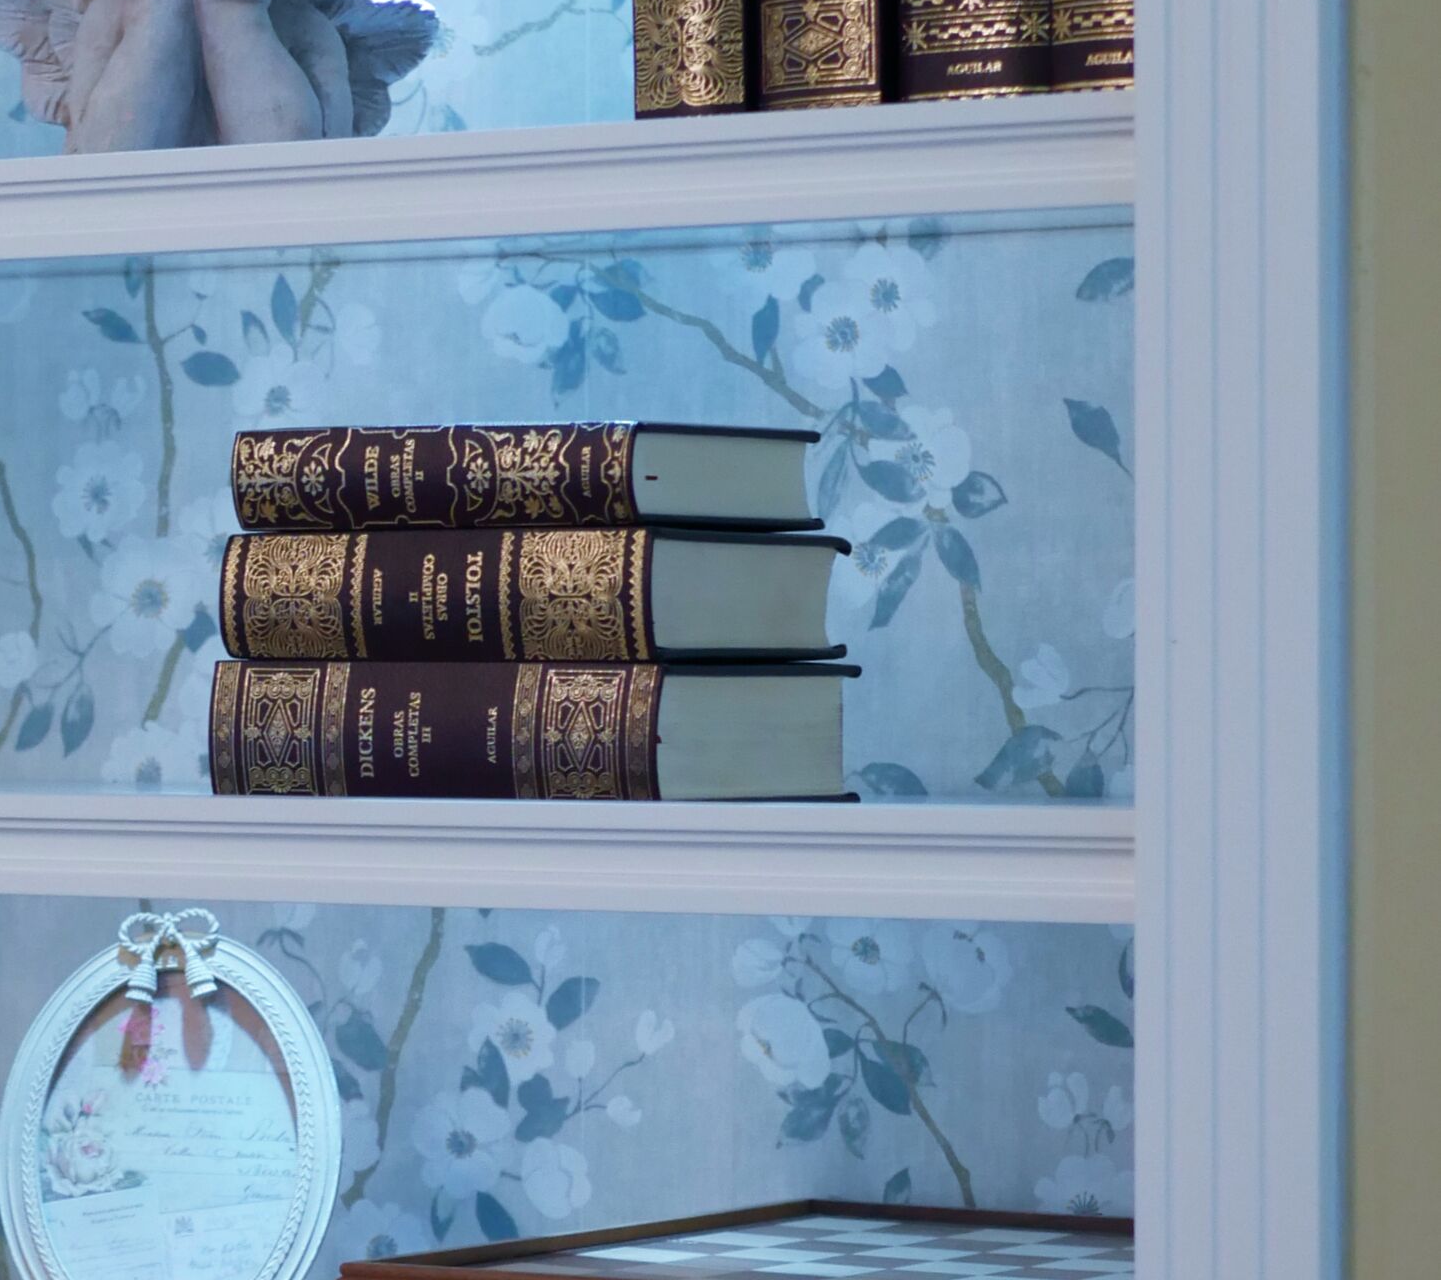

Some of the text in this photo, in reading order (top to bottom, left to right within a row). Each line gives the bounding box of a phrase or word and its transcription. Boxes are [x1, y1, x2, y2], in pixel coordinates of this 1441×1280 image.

[946, 60, 1003, 76] AGUILAR
[364, 445, 380, 510] WILDE
[390, 454, 401, 498] OBRAS
[404, 438, 416, 513] COMPLETAS
[415, 471, 424, 482] II
[581, 446, 592, 498] AGUILAR
[372, 568, 383, 625] AGUILAR
[408, 592, 418, 603] II
[421, 553, 435, 640] COMPLETAS
[436, 572, 448, 622] OBRAS
[465, 551, 484, 642] TOLSTOI
[358, 687, 376, 778] DICKENS
[393, 710, 405, 759] OBRAS
[408, 691, 422, 777] COMPLETAS
[421, 726, 432, 744] III
[486, 706, 498, 764] AGUILAR
[135, 1092, 254, 1105] CARTE POSTALE
